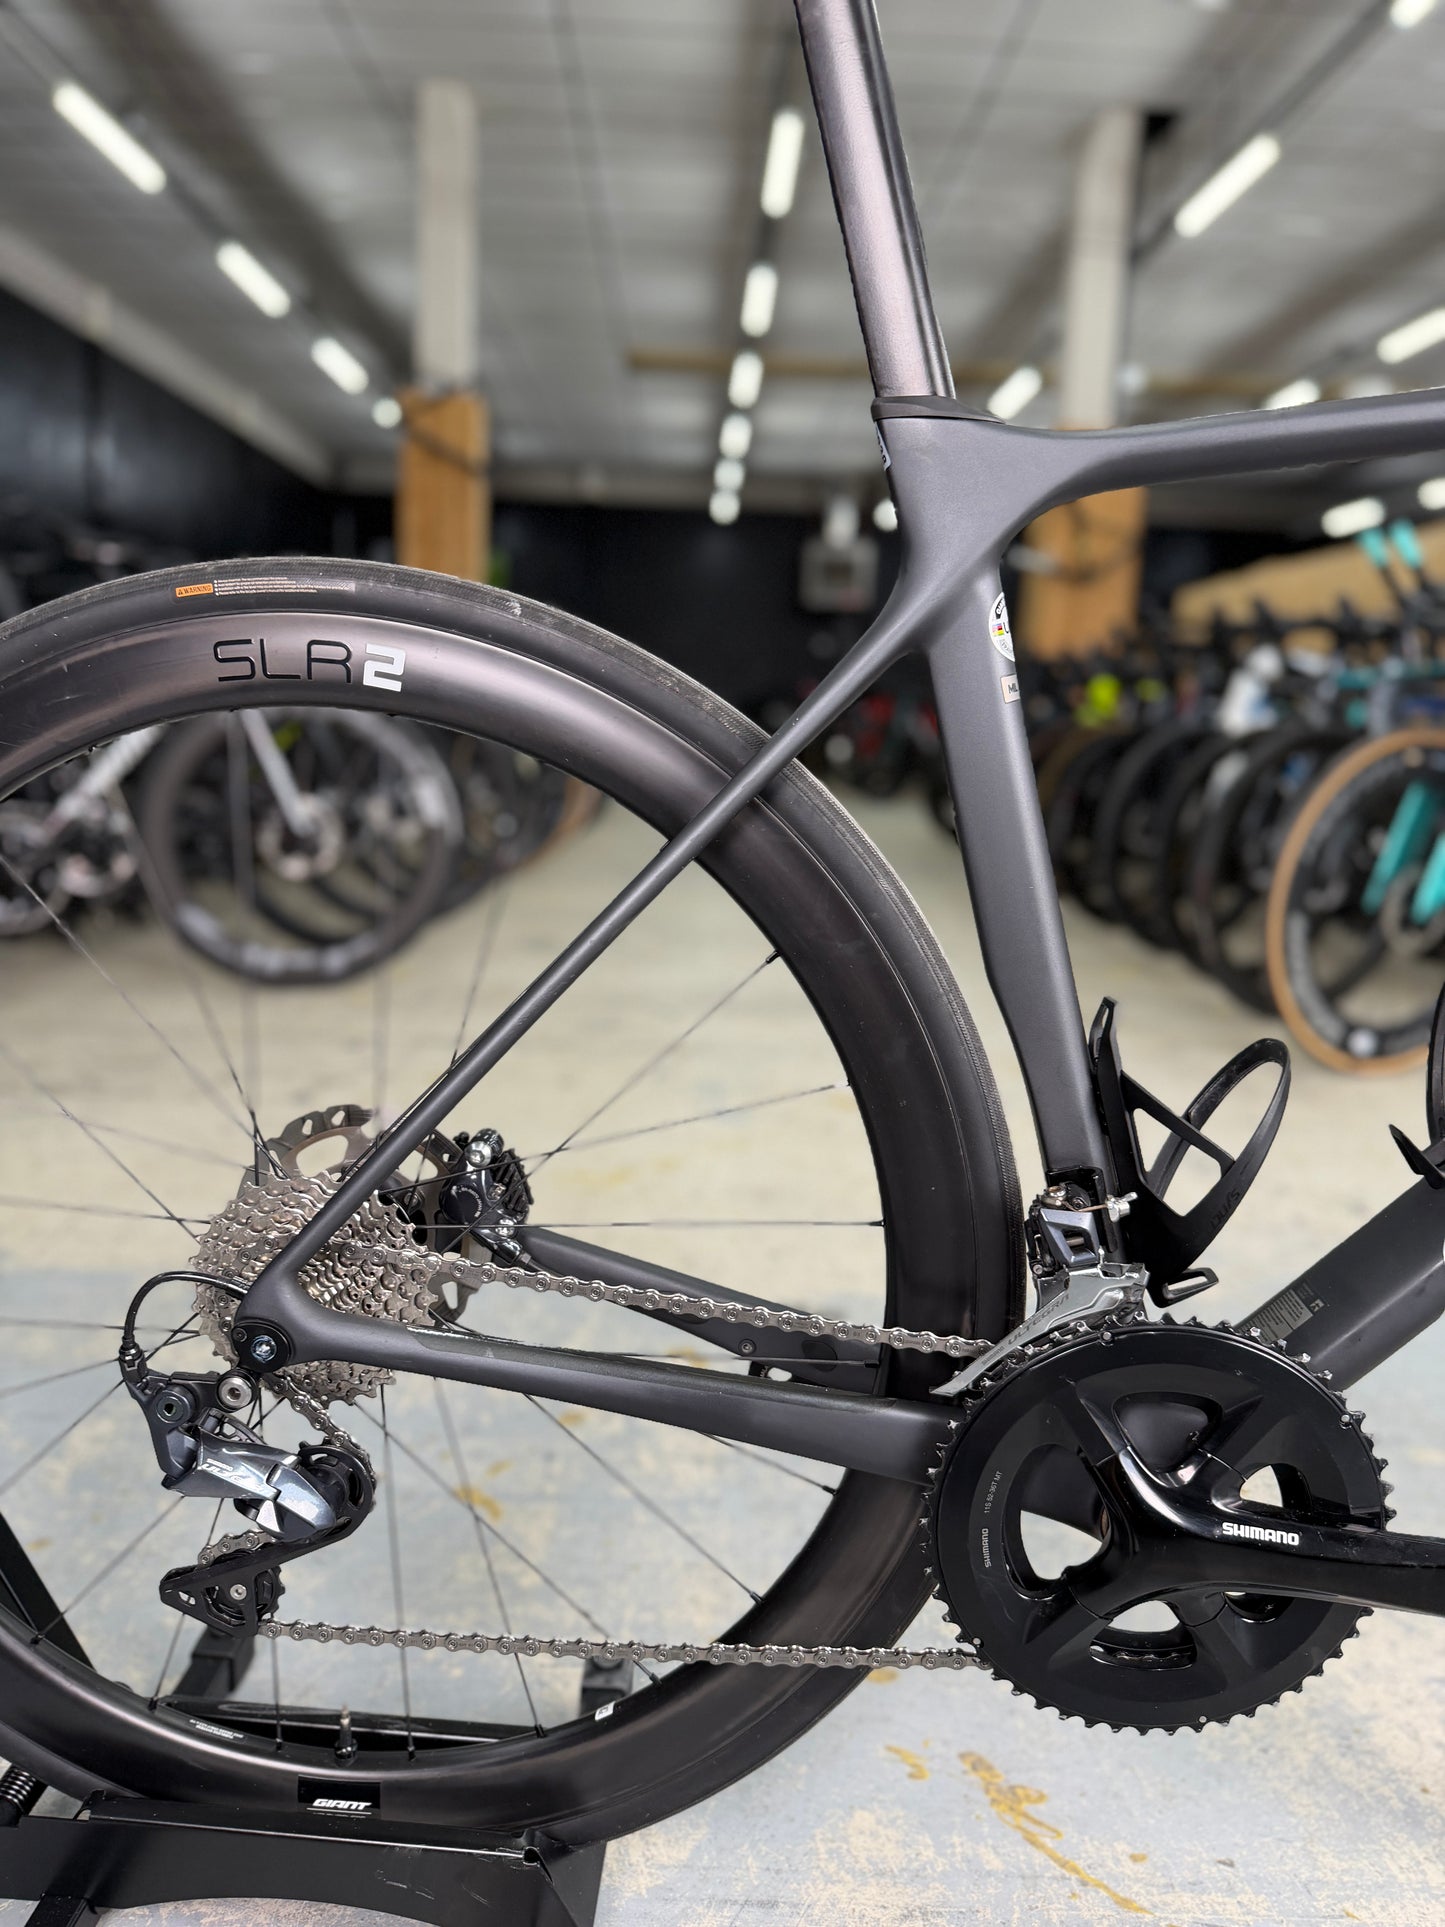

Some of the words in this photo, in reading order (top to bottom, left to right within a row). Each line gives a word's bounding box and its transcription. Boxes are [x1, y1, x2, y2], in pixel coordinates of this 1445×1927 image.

[984, 1501, 992, 1514] 11S
[1222, 1522, 1300, 1546] SHIMANO
[981, 1528, 992, 1568] SHIMANO
[312, 1798, 373, 1811] GIANT
